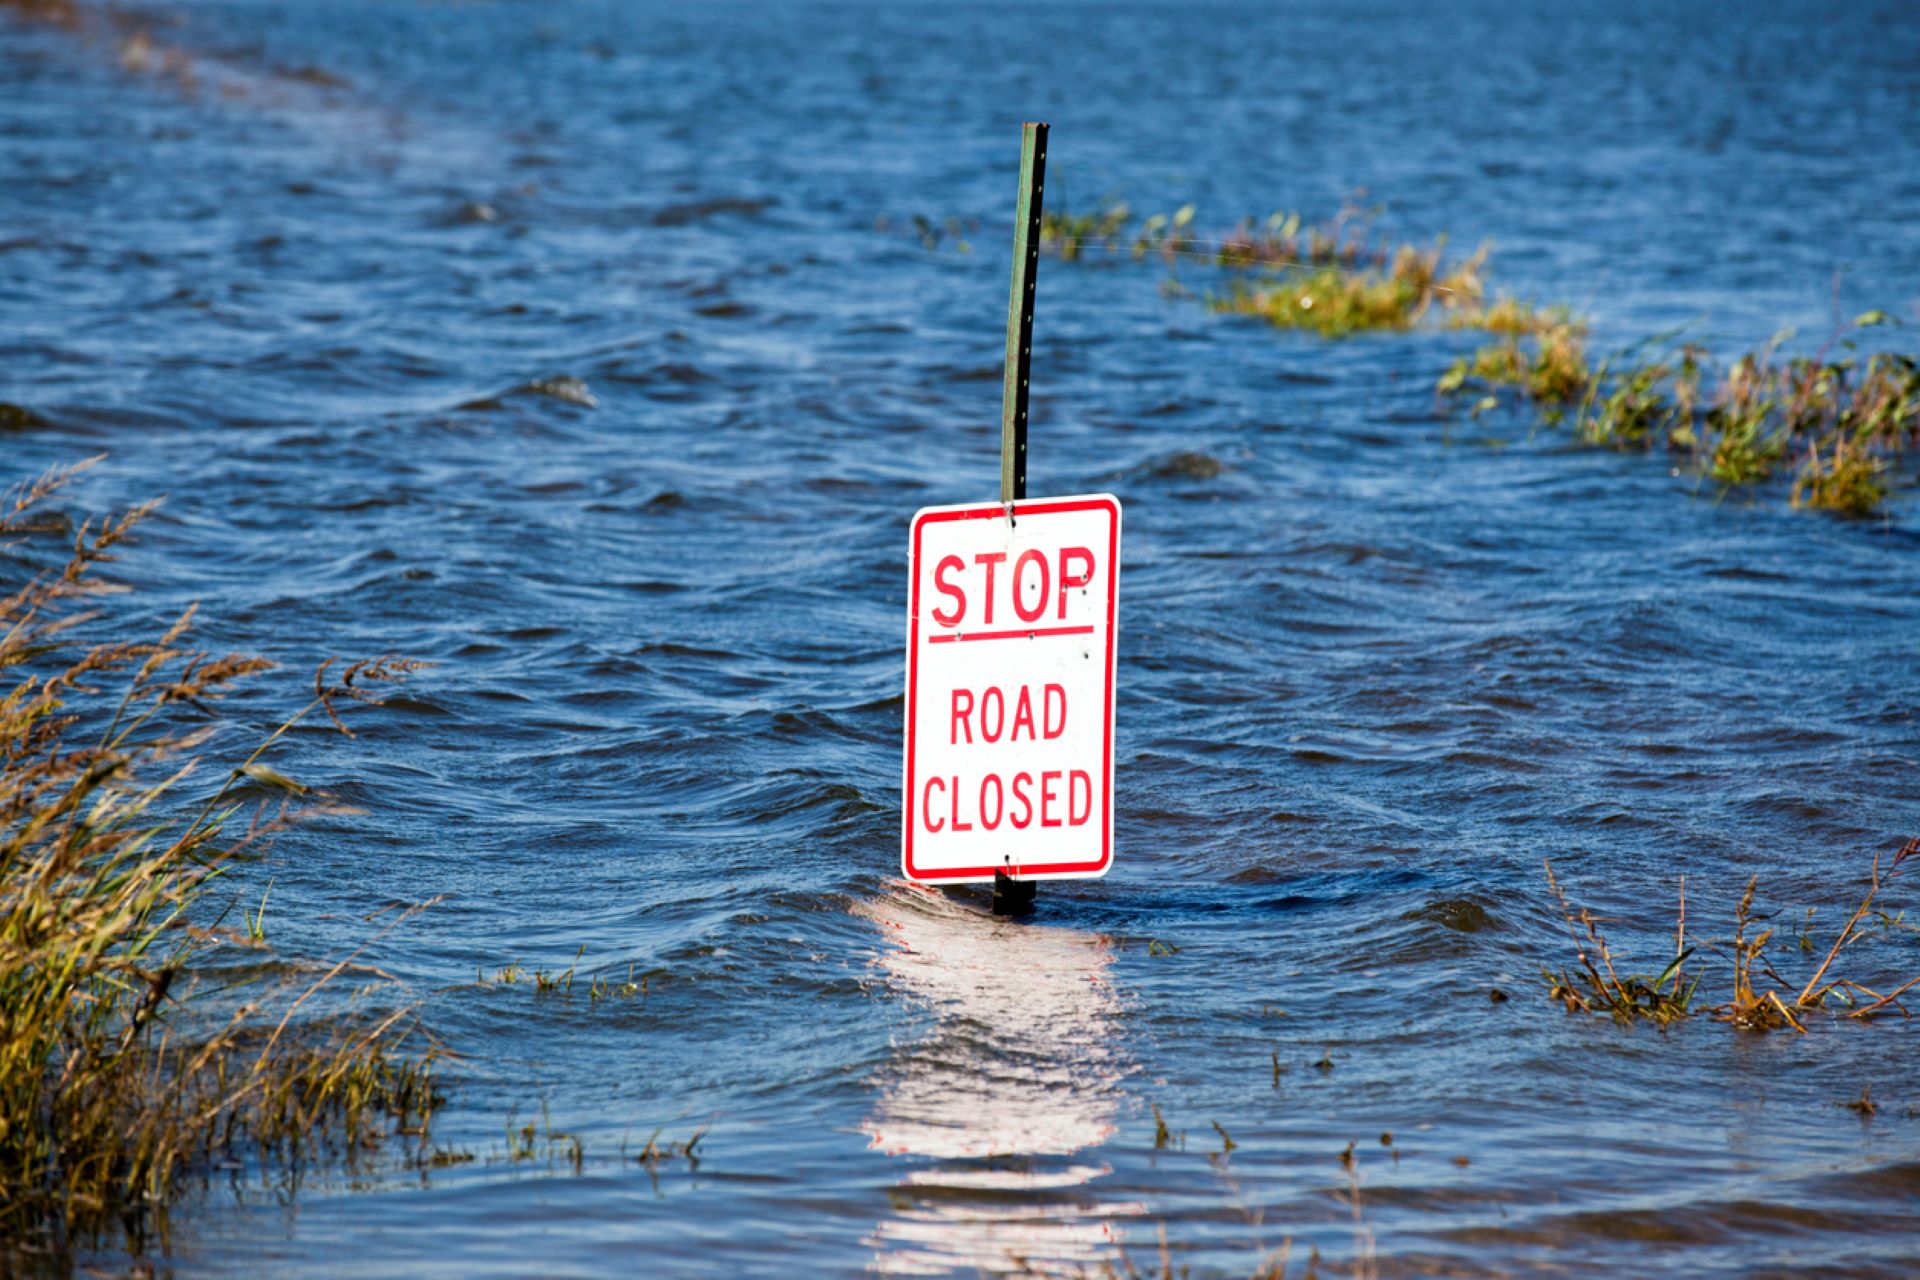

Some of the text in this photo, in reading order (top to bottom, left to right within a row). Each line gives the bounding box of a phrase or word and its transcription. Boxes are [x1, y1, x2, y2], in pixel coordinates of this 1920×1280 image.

[932, 546, 1095, 628] STOP
[951, 683, 1067, 744] ROAD
[923, 770, 1092, 833] CLOSED
